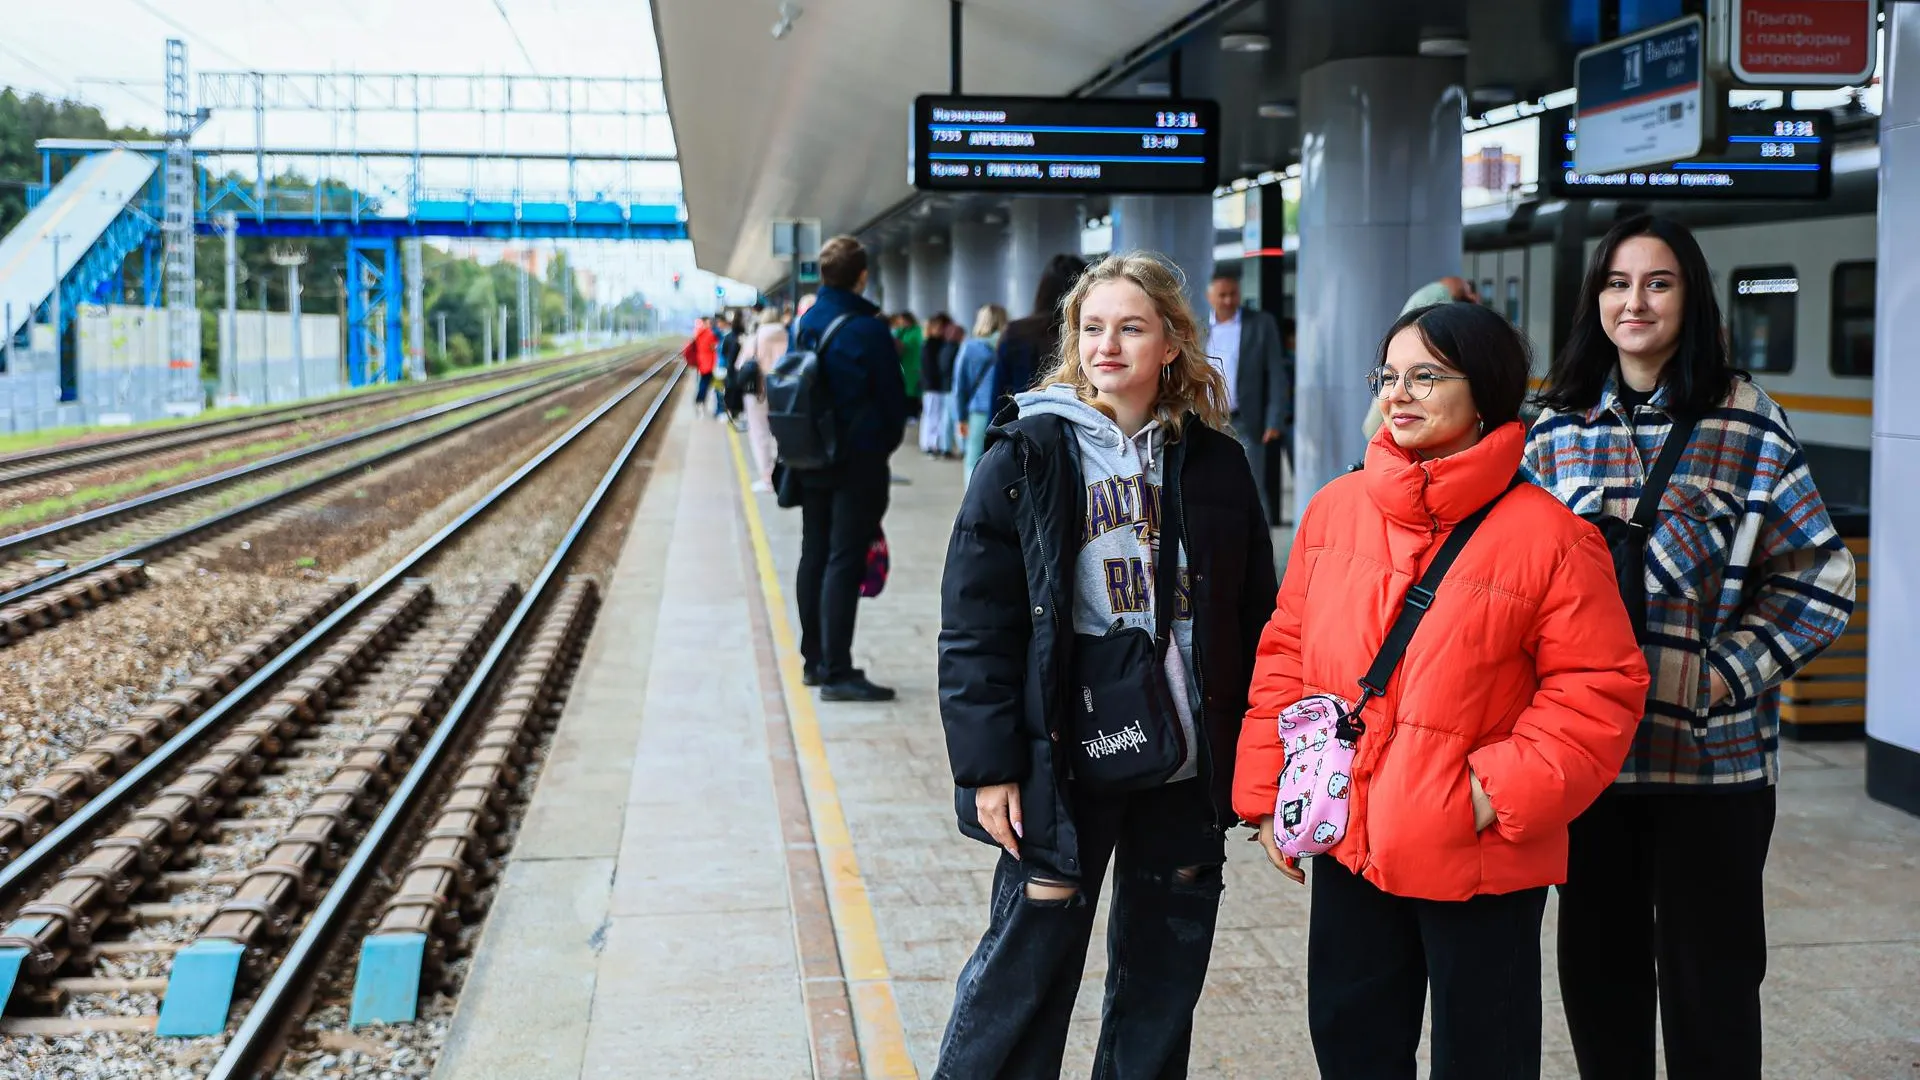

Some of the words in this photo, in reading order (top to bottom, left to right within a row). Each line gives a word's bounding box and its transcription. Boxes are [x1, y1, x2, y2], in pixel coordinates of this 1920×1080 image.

[1747, 10, 1813, 28] Прыгать
[1746, 35, 1753, 45] с
[1757, 32, 1850, 47] платформы
[1746, 52, 1841, 67] запрещено!
[1156, 112, 1198, 127] 13:31
